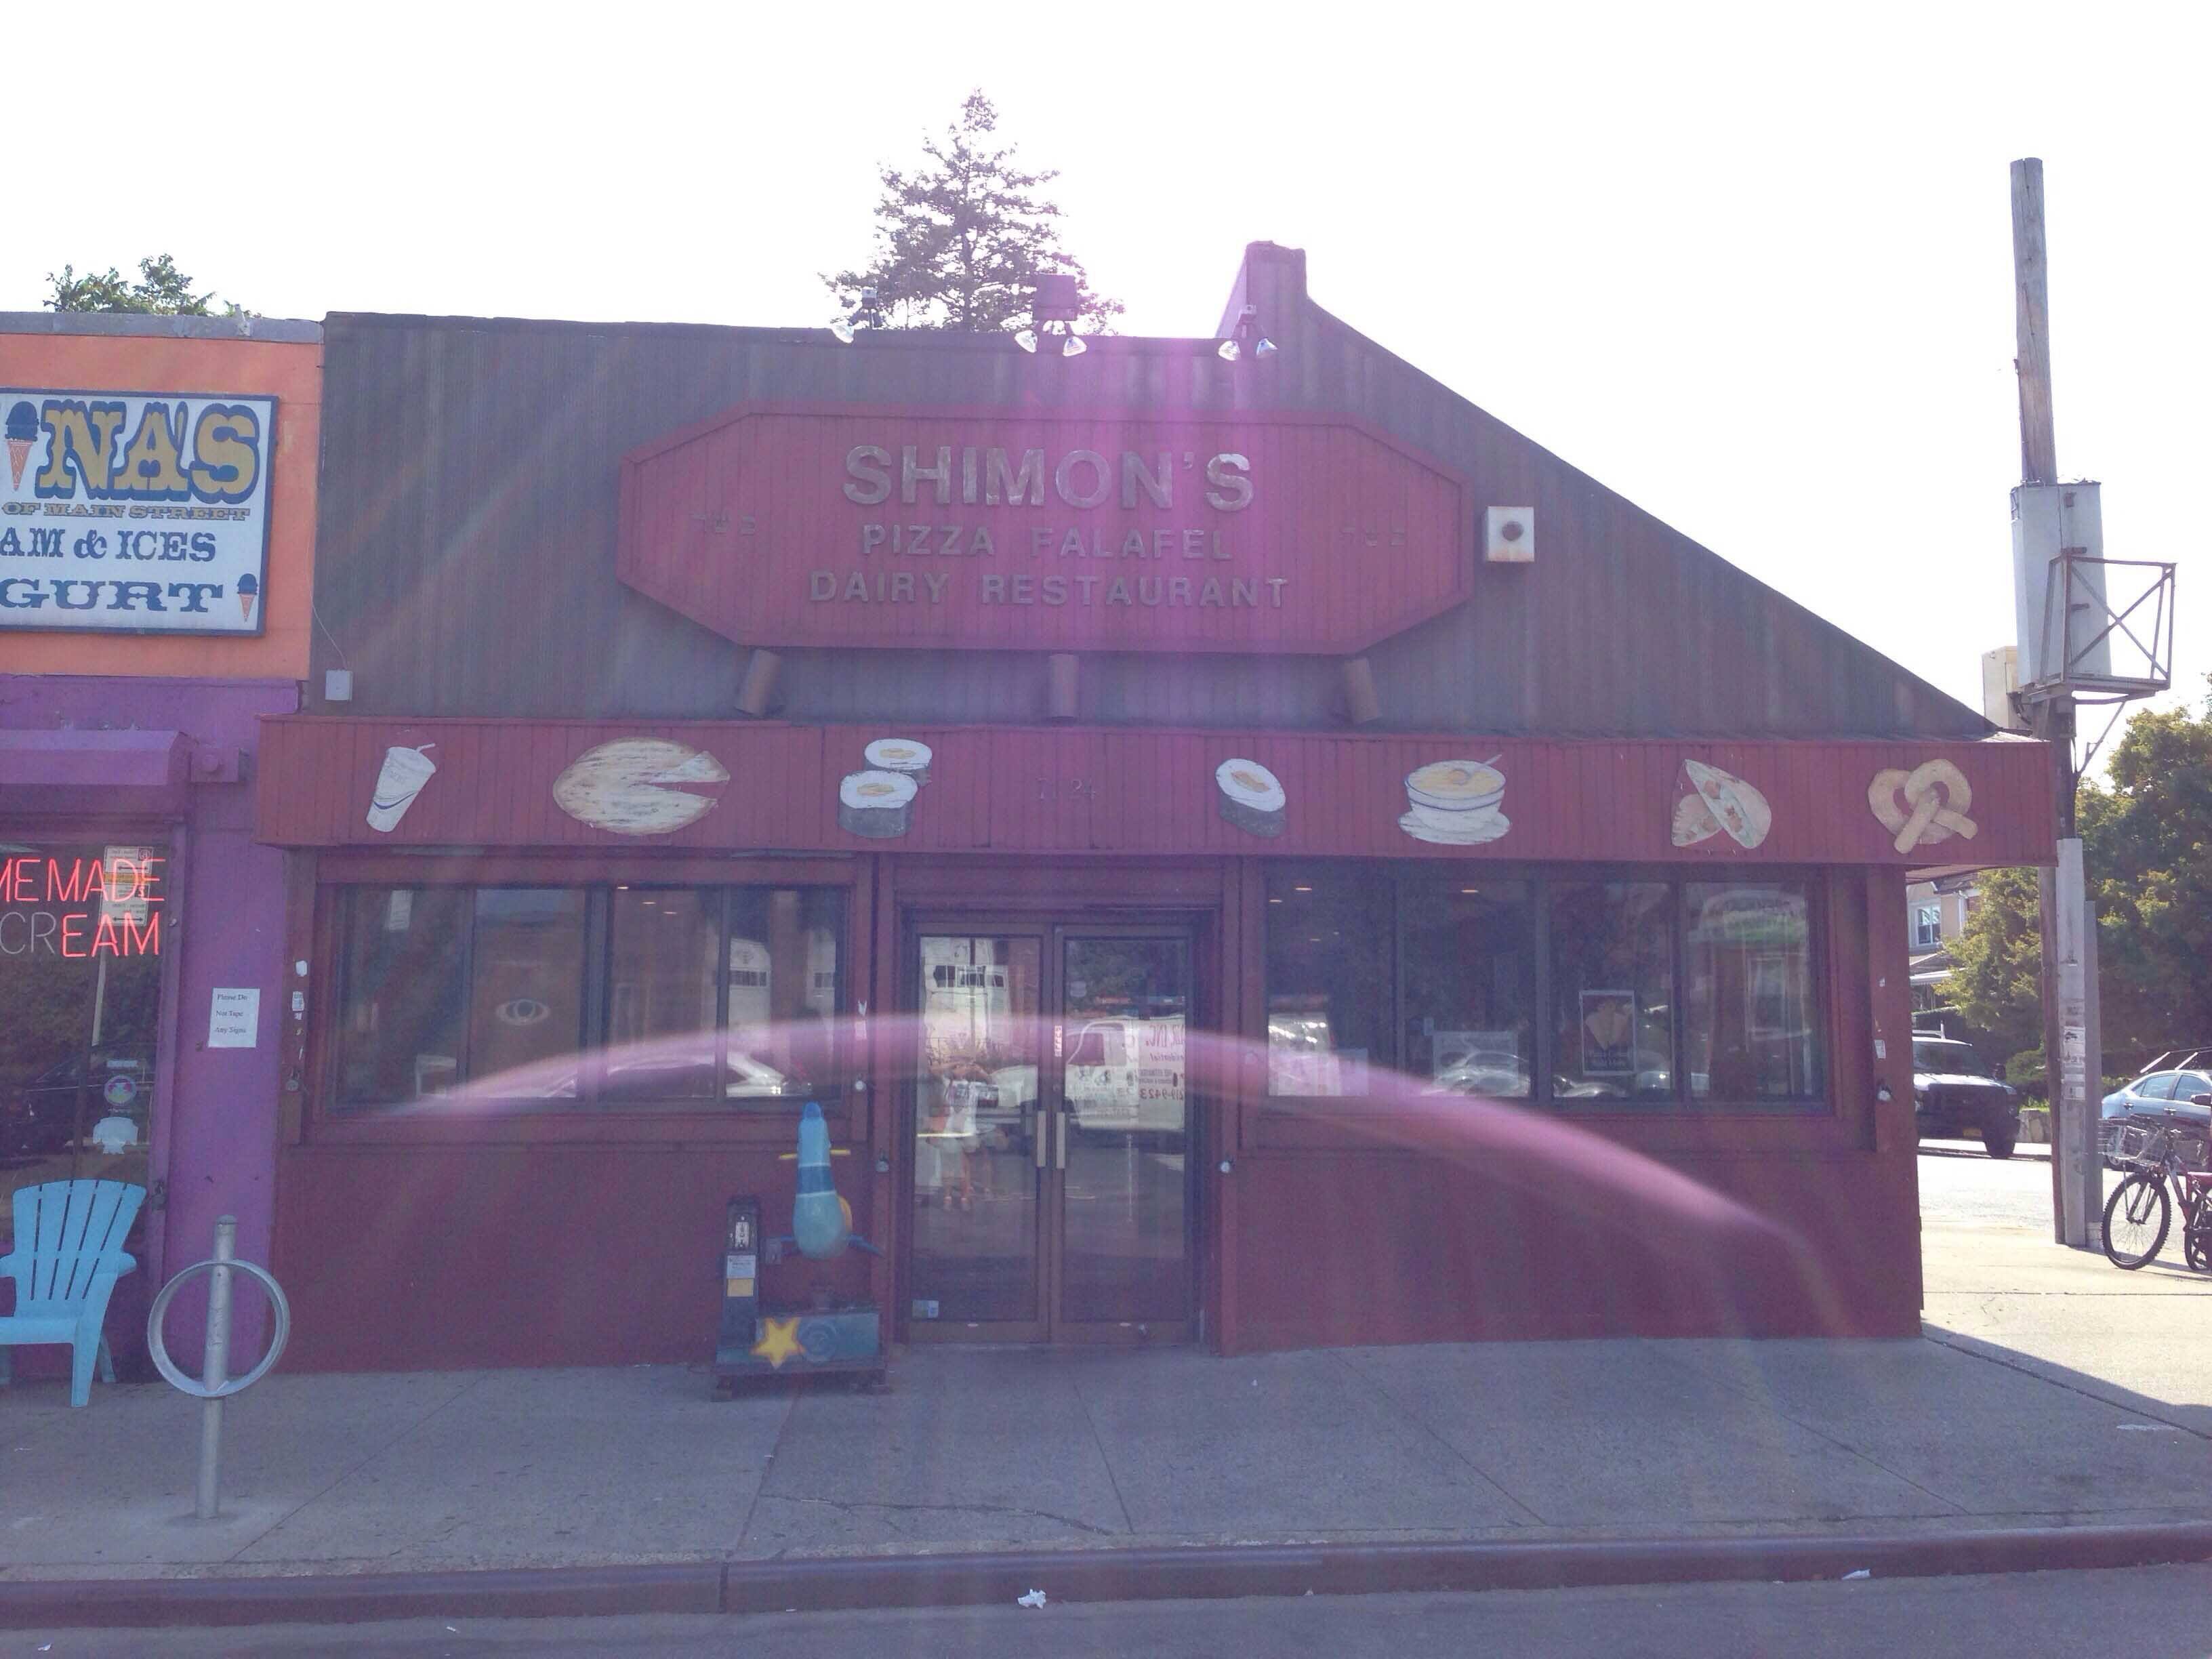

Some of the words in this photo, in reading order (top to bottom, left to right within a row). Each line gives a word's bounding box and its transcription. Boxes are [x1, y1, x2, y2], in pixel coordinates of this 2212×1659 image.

[842, 445, 1255, 512] SHIMON'S
[1, 501, 41, 515] OF
[43, 503, 126, 518] MAIN
[129, 506, 251, 521] STREET
[73, 529, 107, 559] &
[115, 530, 216, 562] ICES
[861, 524, 995, 556] PIZZA
[1029, 527, 1233, 560] FALAFEL
[810, 571, 951, 604] DAIRY
[981, 573, 1290, 609] RESTAURANT
[0, 910, 161, 958] CREAM
